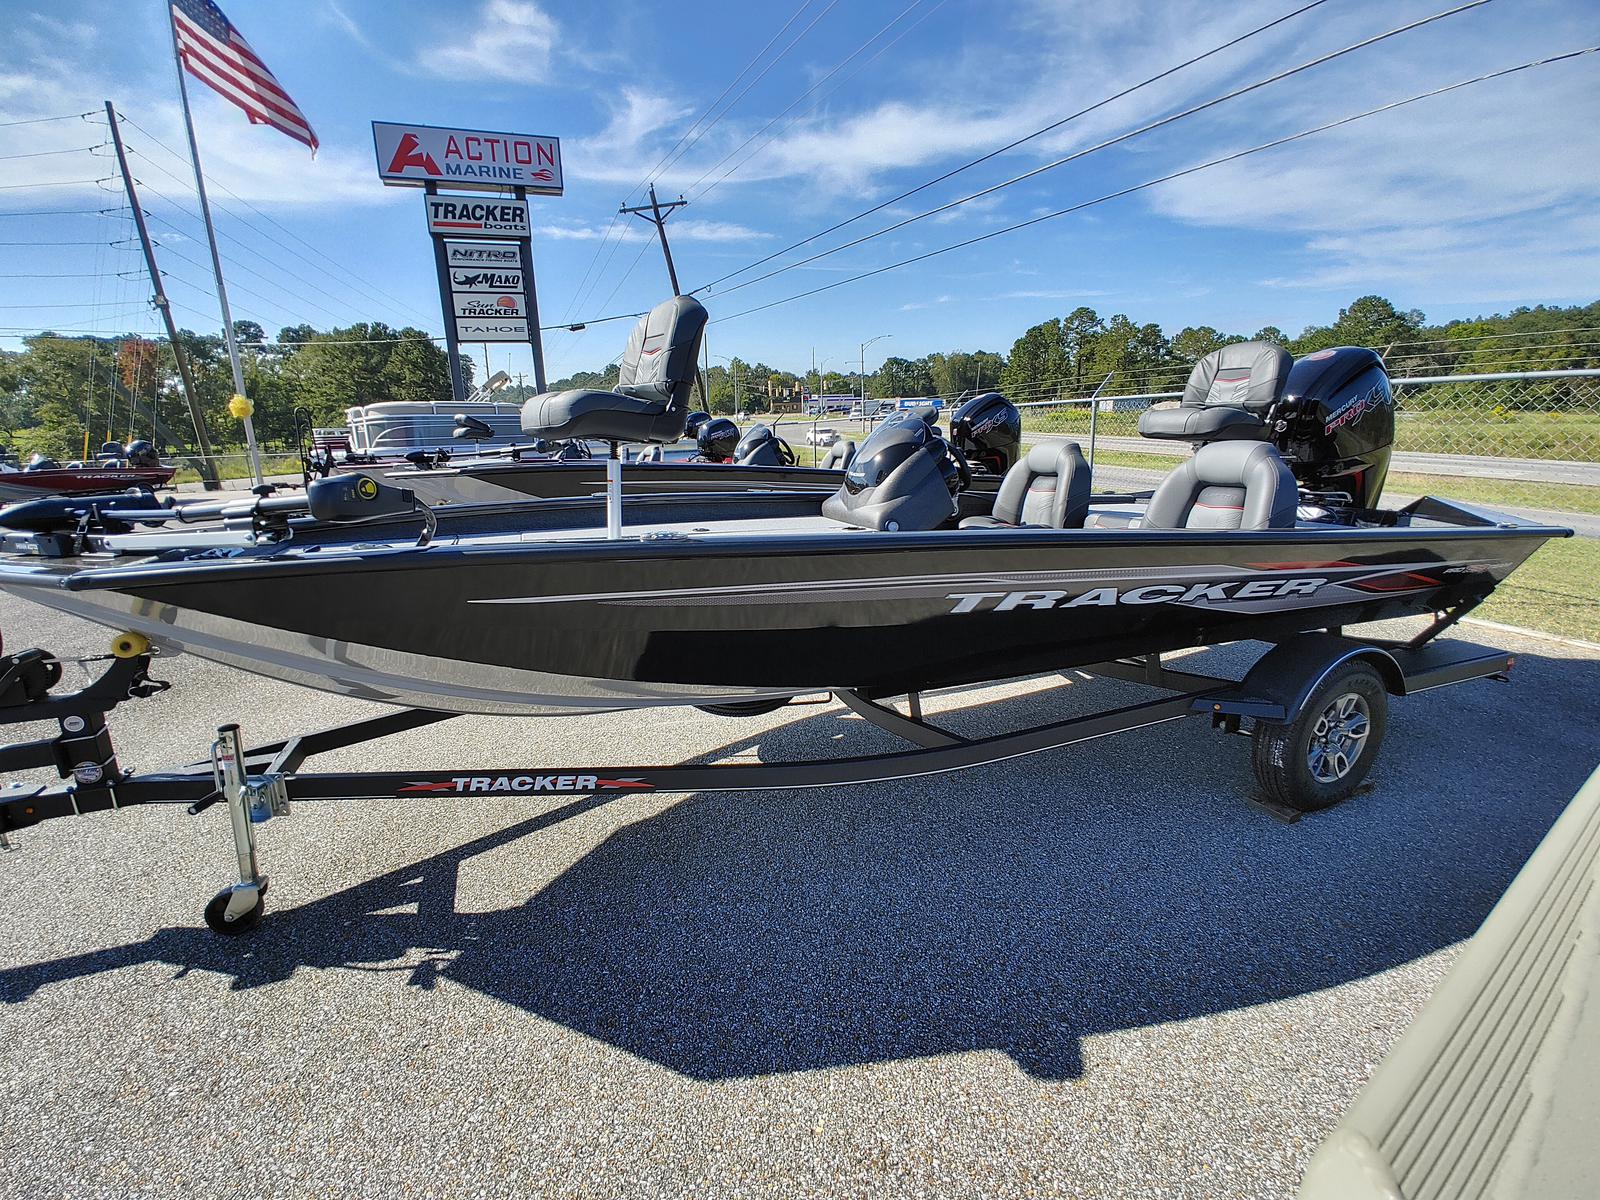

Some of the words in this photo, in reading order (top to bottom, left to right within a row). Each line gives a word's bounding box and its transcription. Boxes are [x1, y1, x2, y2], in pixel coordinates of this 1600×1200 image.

[445, 135, 555, 166] ACTION
[445, 164, 524, 180] MARINE
[430, 201, 525, 223] TRACKER
[484, 221, 527, 231] boats
[452, 248, 517, 259] NITRO
[477, 273, 521, 288] MAKO
[461, 308, 519, 316] TRACKER
[1325, 394, 1358, 423] MERCURY
[945, 577, 1328, 614] TRACKER
[452, 775, 598, 792] TRACKER
